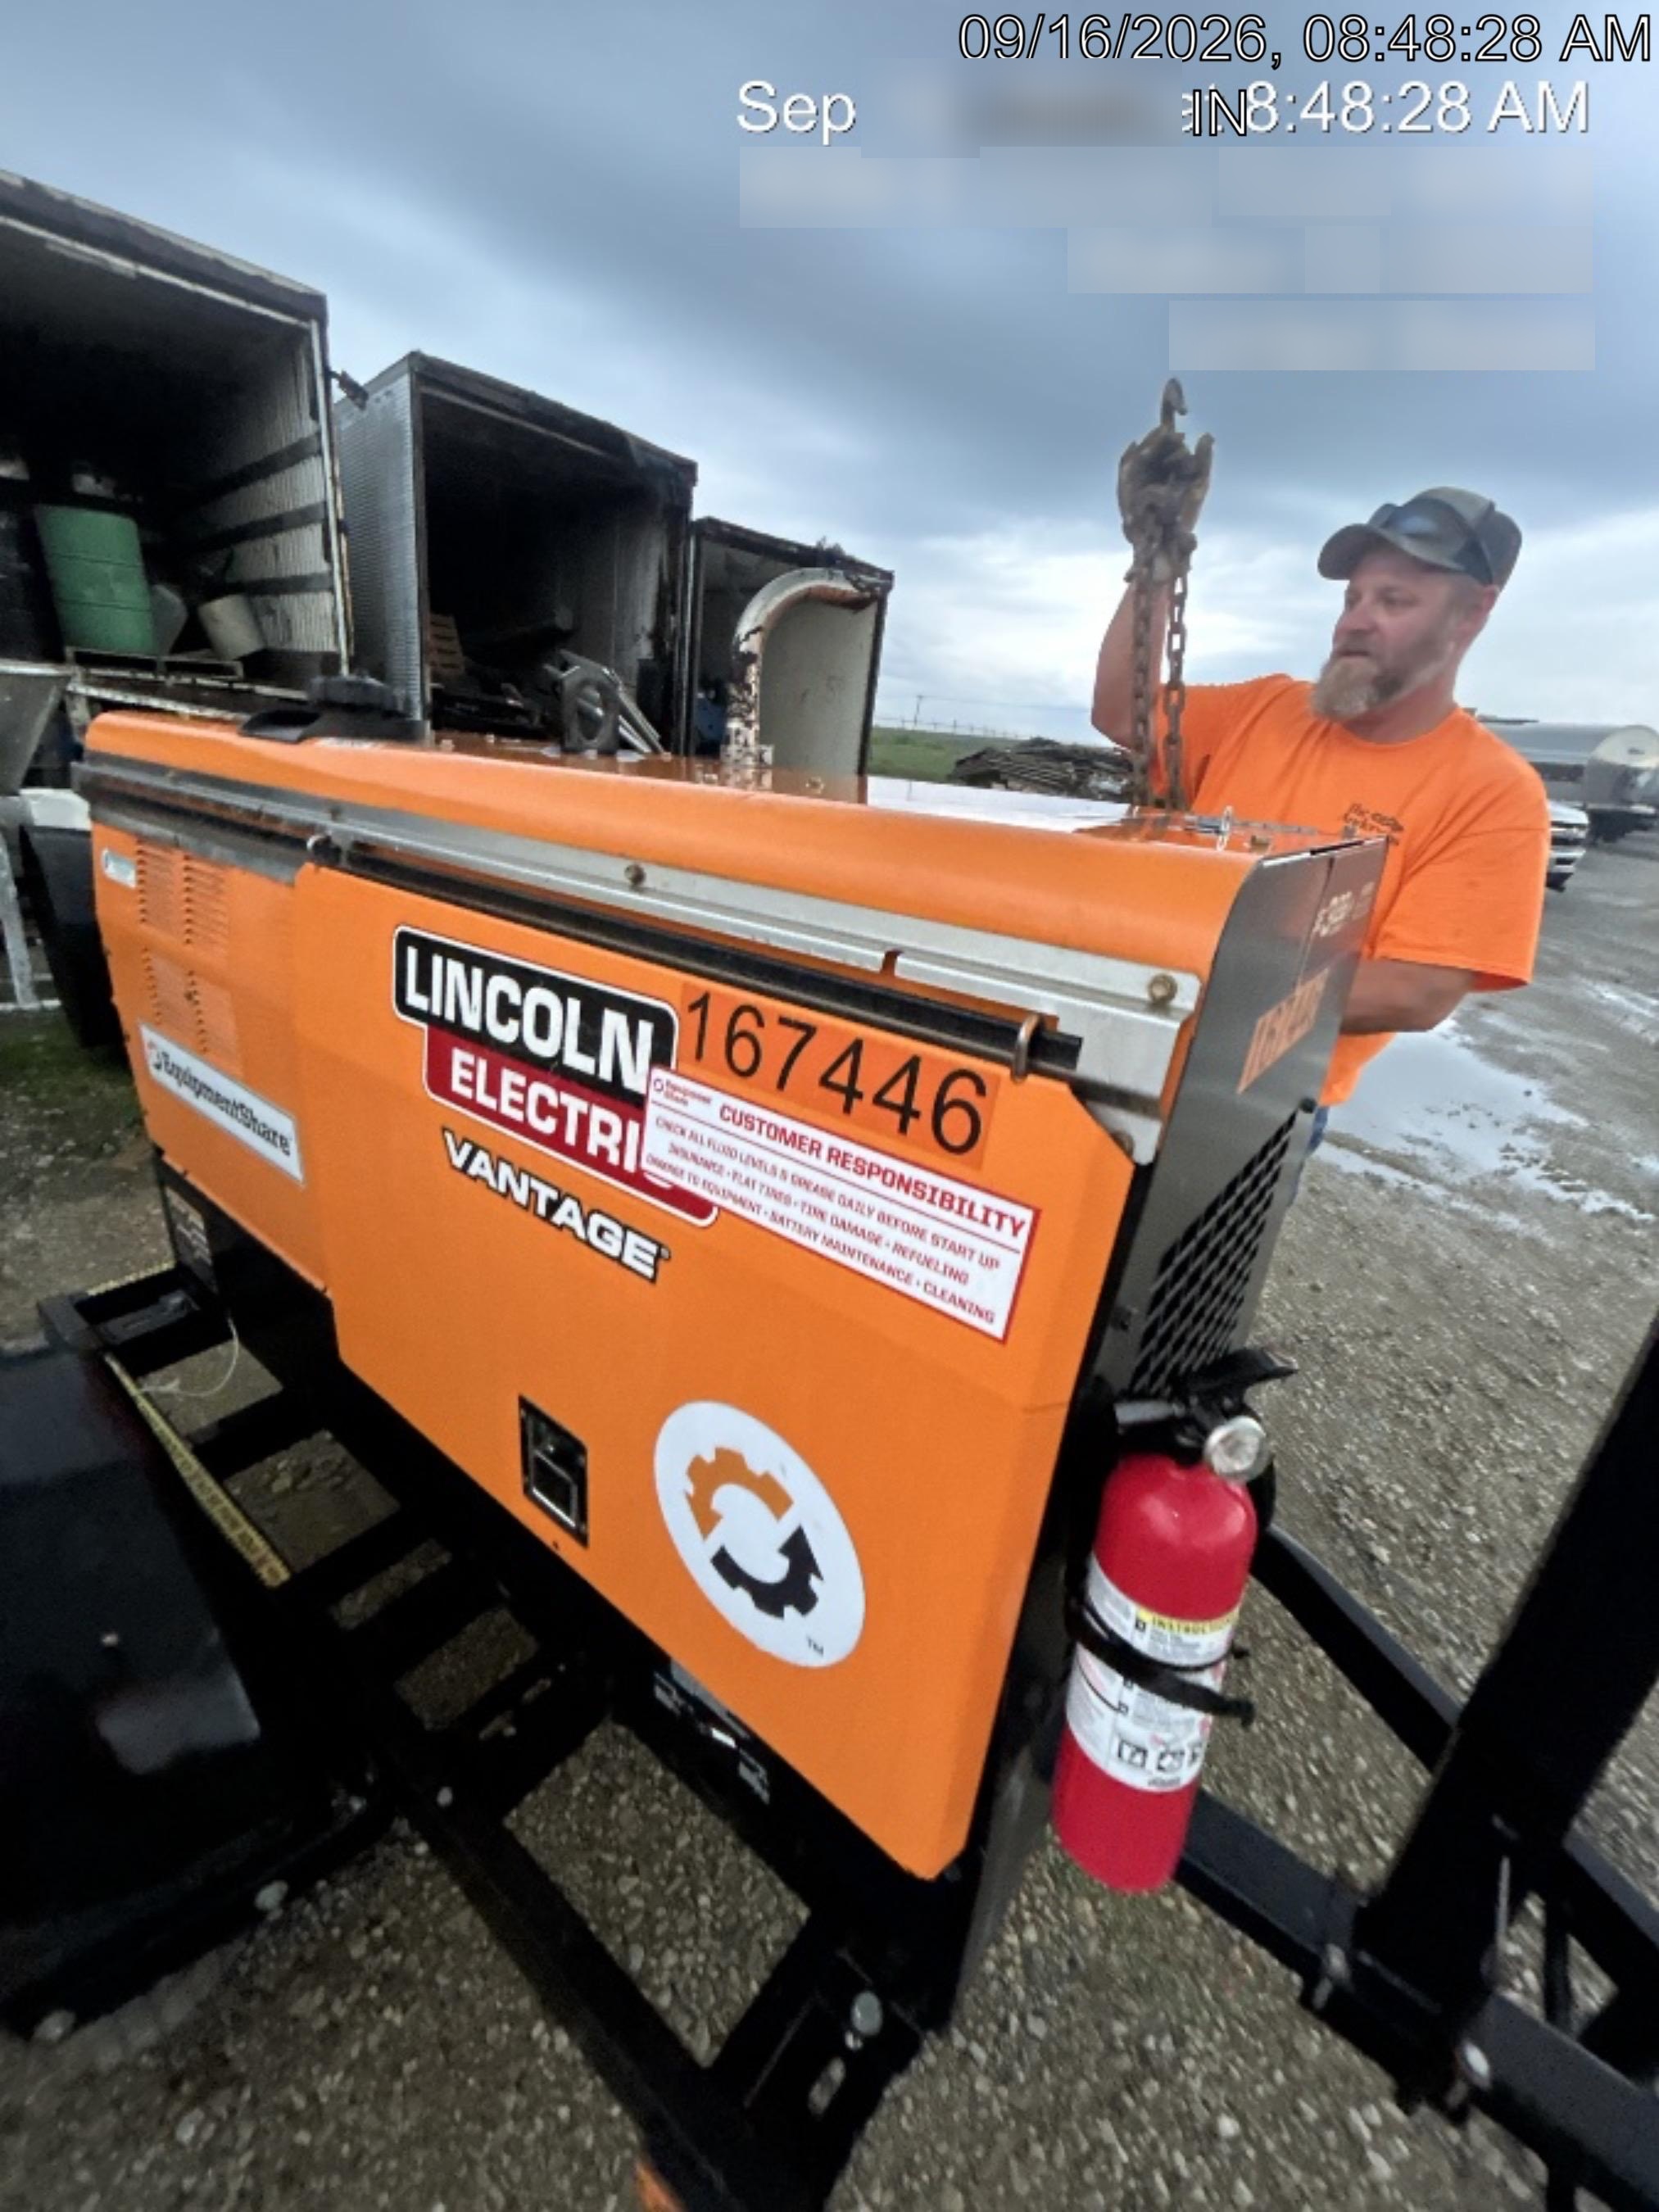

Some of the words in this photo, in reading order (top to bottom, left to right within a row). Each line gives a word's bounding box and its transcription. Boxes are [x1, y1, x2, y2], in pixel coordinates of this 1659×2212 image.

[406, 946, 654, 1095] LINCOLN
[687, 990, 986, 1156] 167446
[451, 1048, 673, 1190] ELECTRI
[719, 1104, 823, 1159] CUSTOMER
[827, 1147, 1027, 1238] RESPONSIBILITY
[442, 1128, 658, 1284] VANTAGE
[688, 1129, 705, 1147] ALL
[740, 1150, 777, 1178] LEVELS
[791, 1173, 836, 1201] GREASE
[838, 1194, 875, 1218] DAILY
[877, 1211, 927, 1241] BEFORE
[931, 1232, 976, 1262] START
[979, 1251, 999, 1269] UP
[732, 1171, 757, 1190] FLAT
[759, 1183, 791, 1206] TIRES
[800, 1200, 827, 1222] TIRE
[830, 1213, 883, 1246] DAMAGE
[891, 1242, 969, 1285] REFUELING
[770, 1210, 819, 1242] BATTERY
[821, 1234, 913, 1285] MAINTENANCE
[923, 1281, 995, 1325] CLEANING
